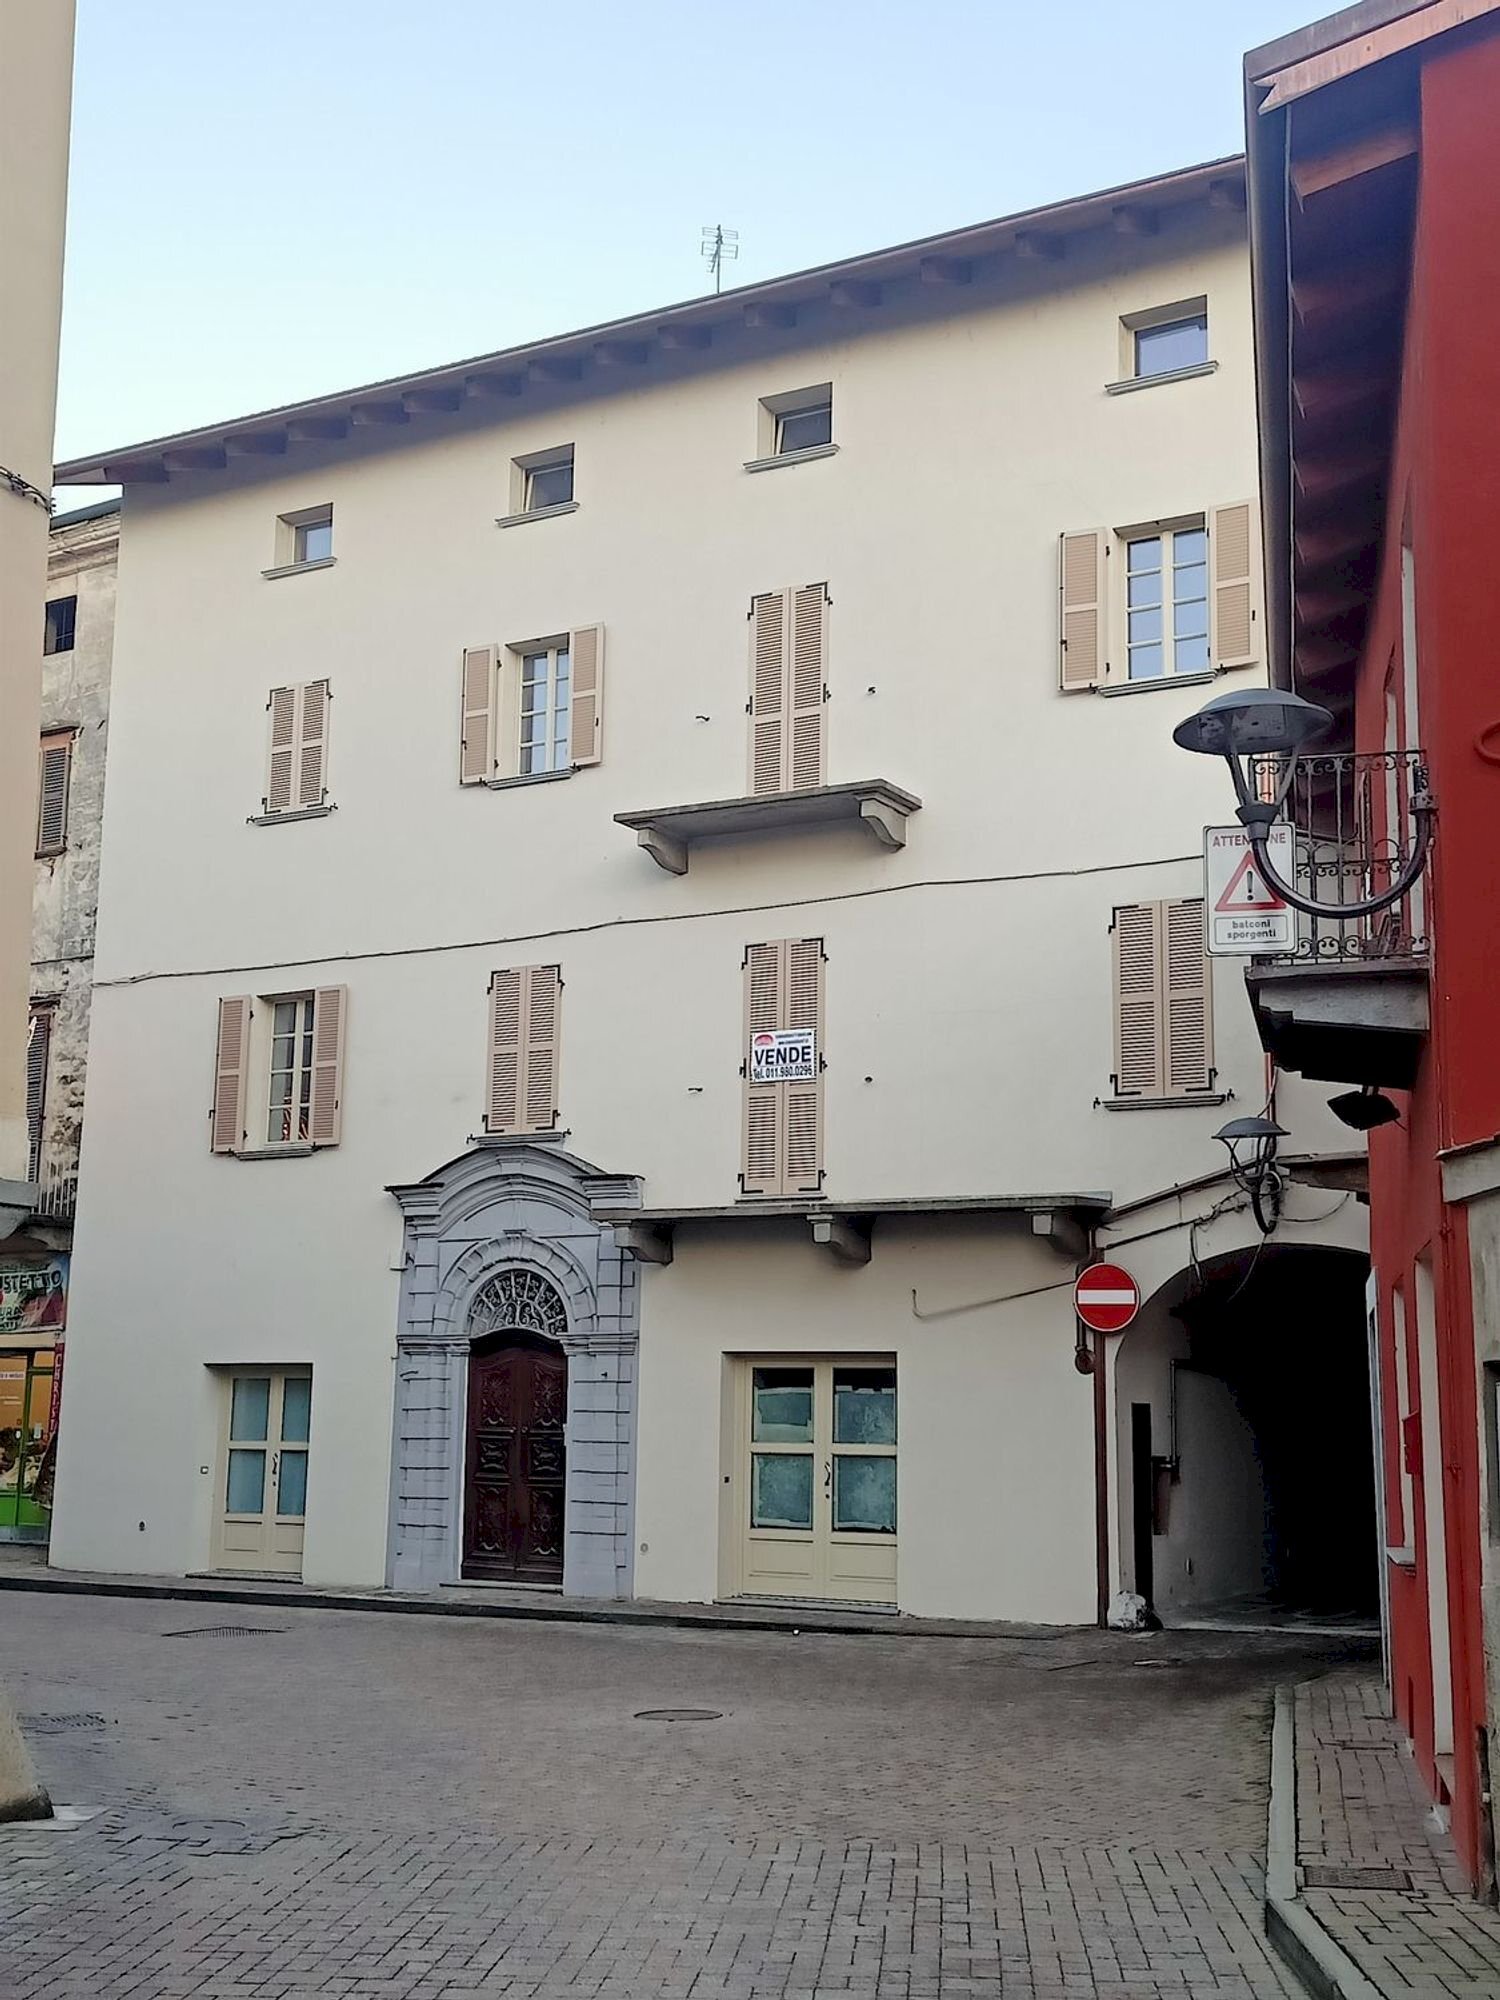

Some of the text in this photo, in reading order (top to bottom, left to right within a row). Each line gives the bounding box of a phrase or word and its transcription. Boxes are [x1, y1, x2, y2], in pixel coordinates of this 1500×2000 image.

[1212, 832, 1287, 847] ATTENNE
[1232, 919, 1271, 929] balconi
[1227, 929, 1276, 940] sporgenti
[754, 1045, 812, 1066] VENDE
